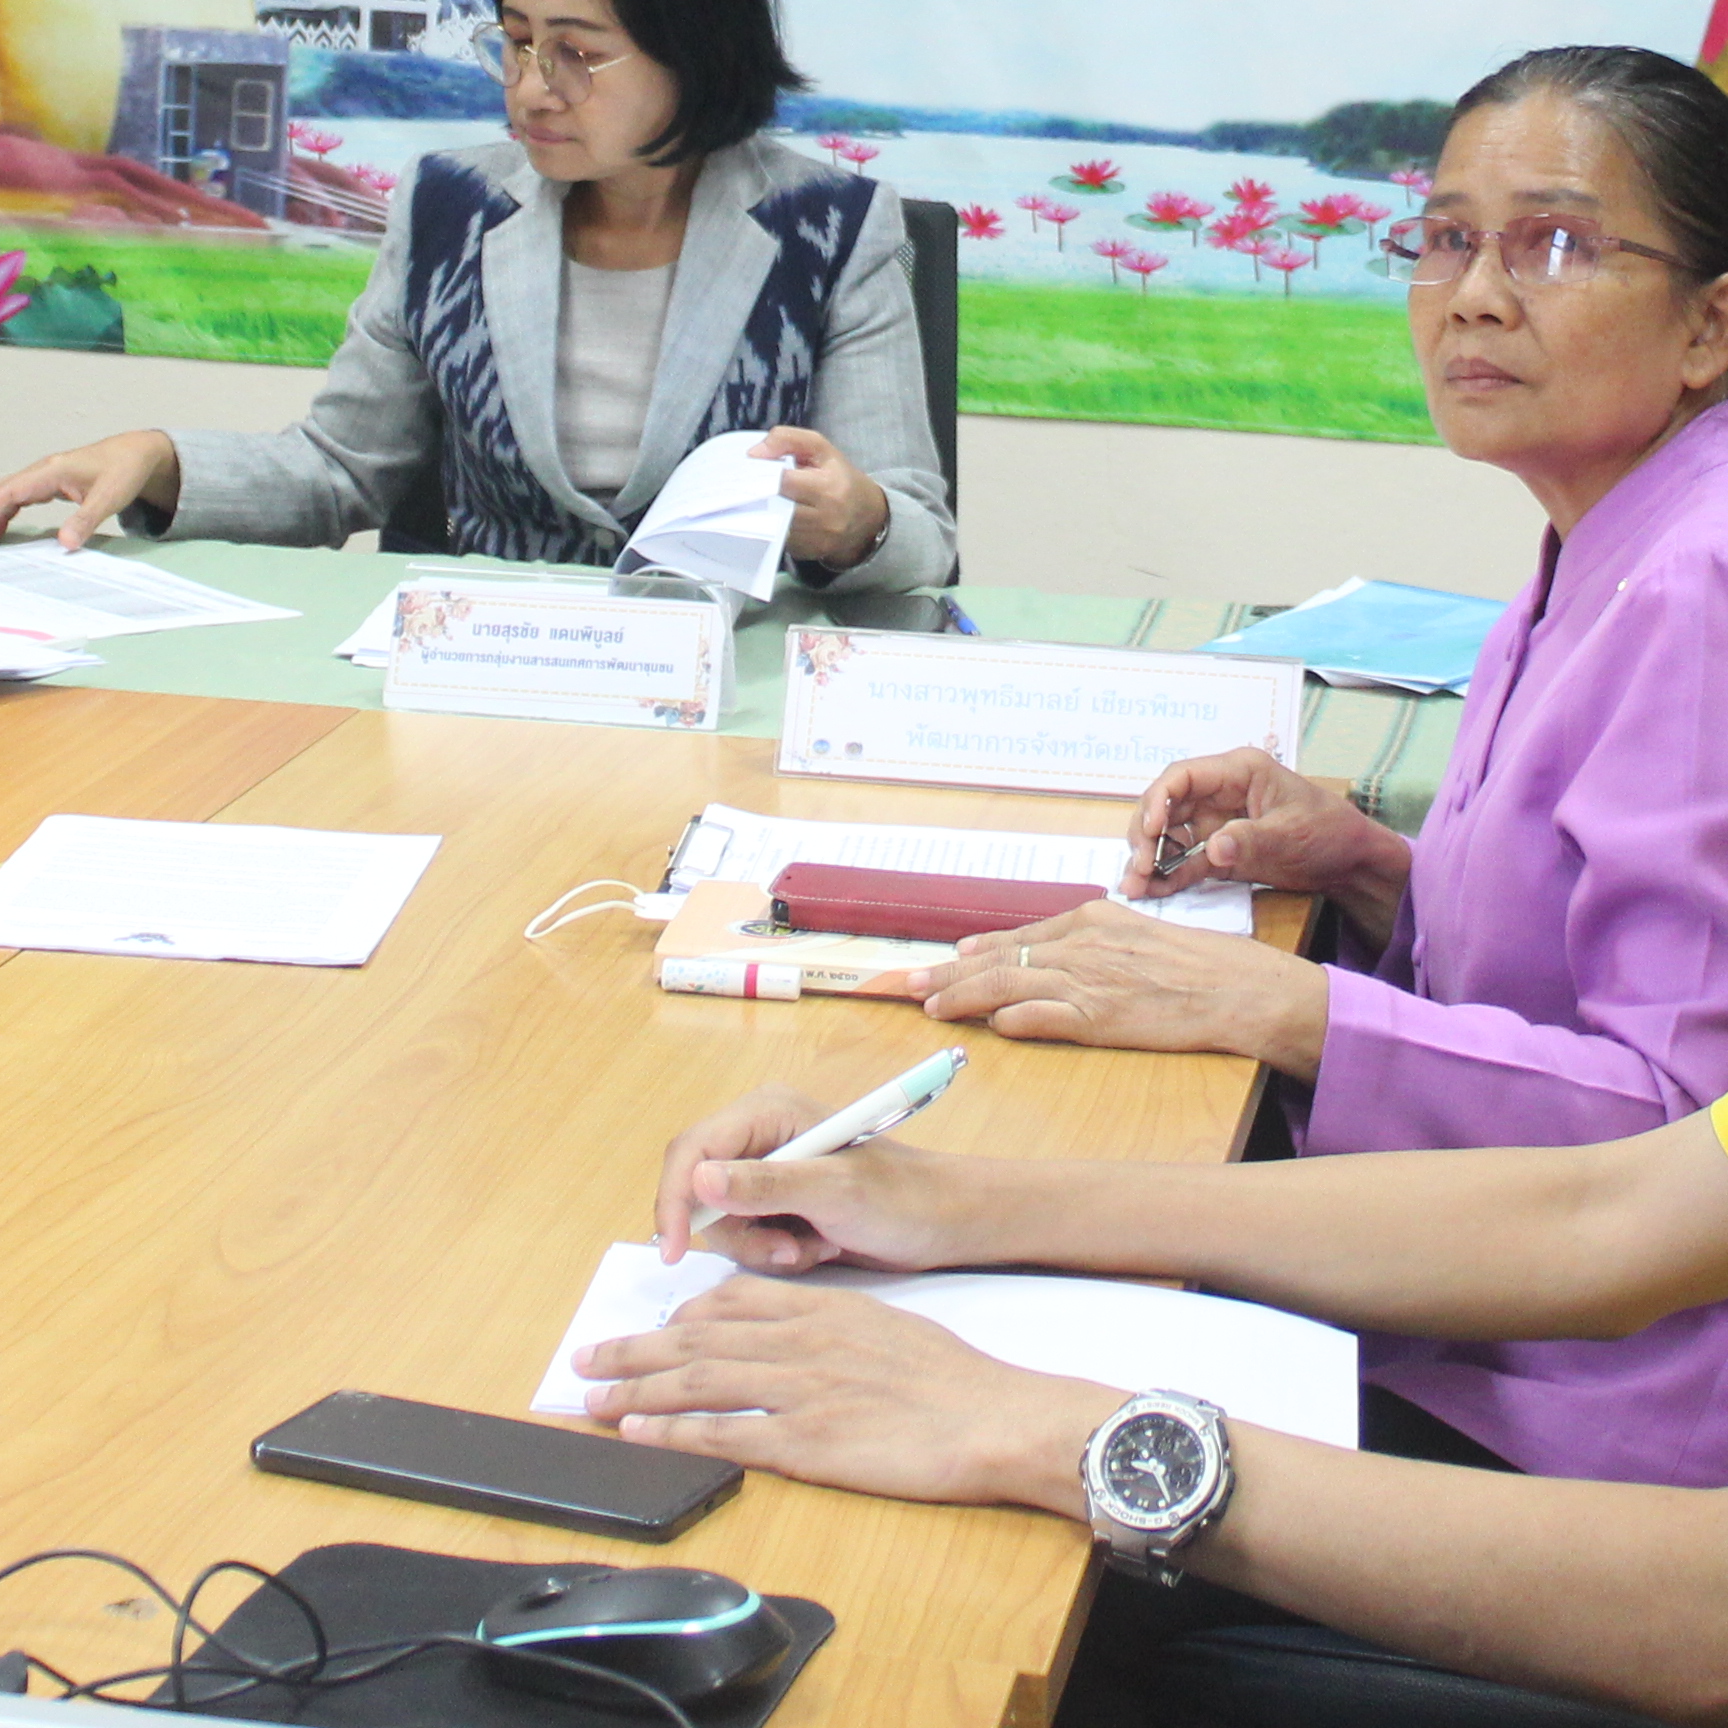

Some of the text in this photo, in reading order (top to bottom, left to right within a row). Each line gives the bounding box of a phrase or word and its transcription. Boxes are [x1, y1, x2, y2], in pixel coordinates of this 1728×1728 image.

[471, 621, 540, 645] นายสุรชัย
[868, 677, 1219, 722] นางสาวพุทธิมาลย์ เชียรพิมาย
